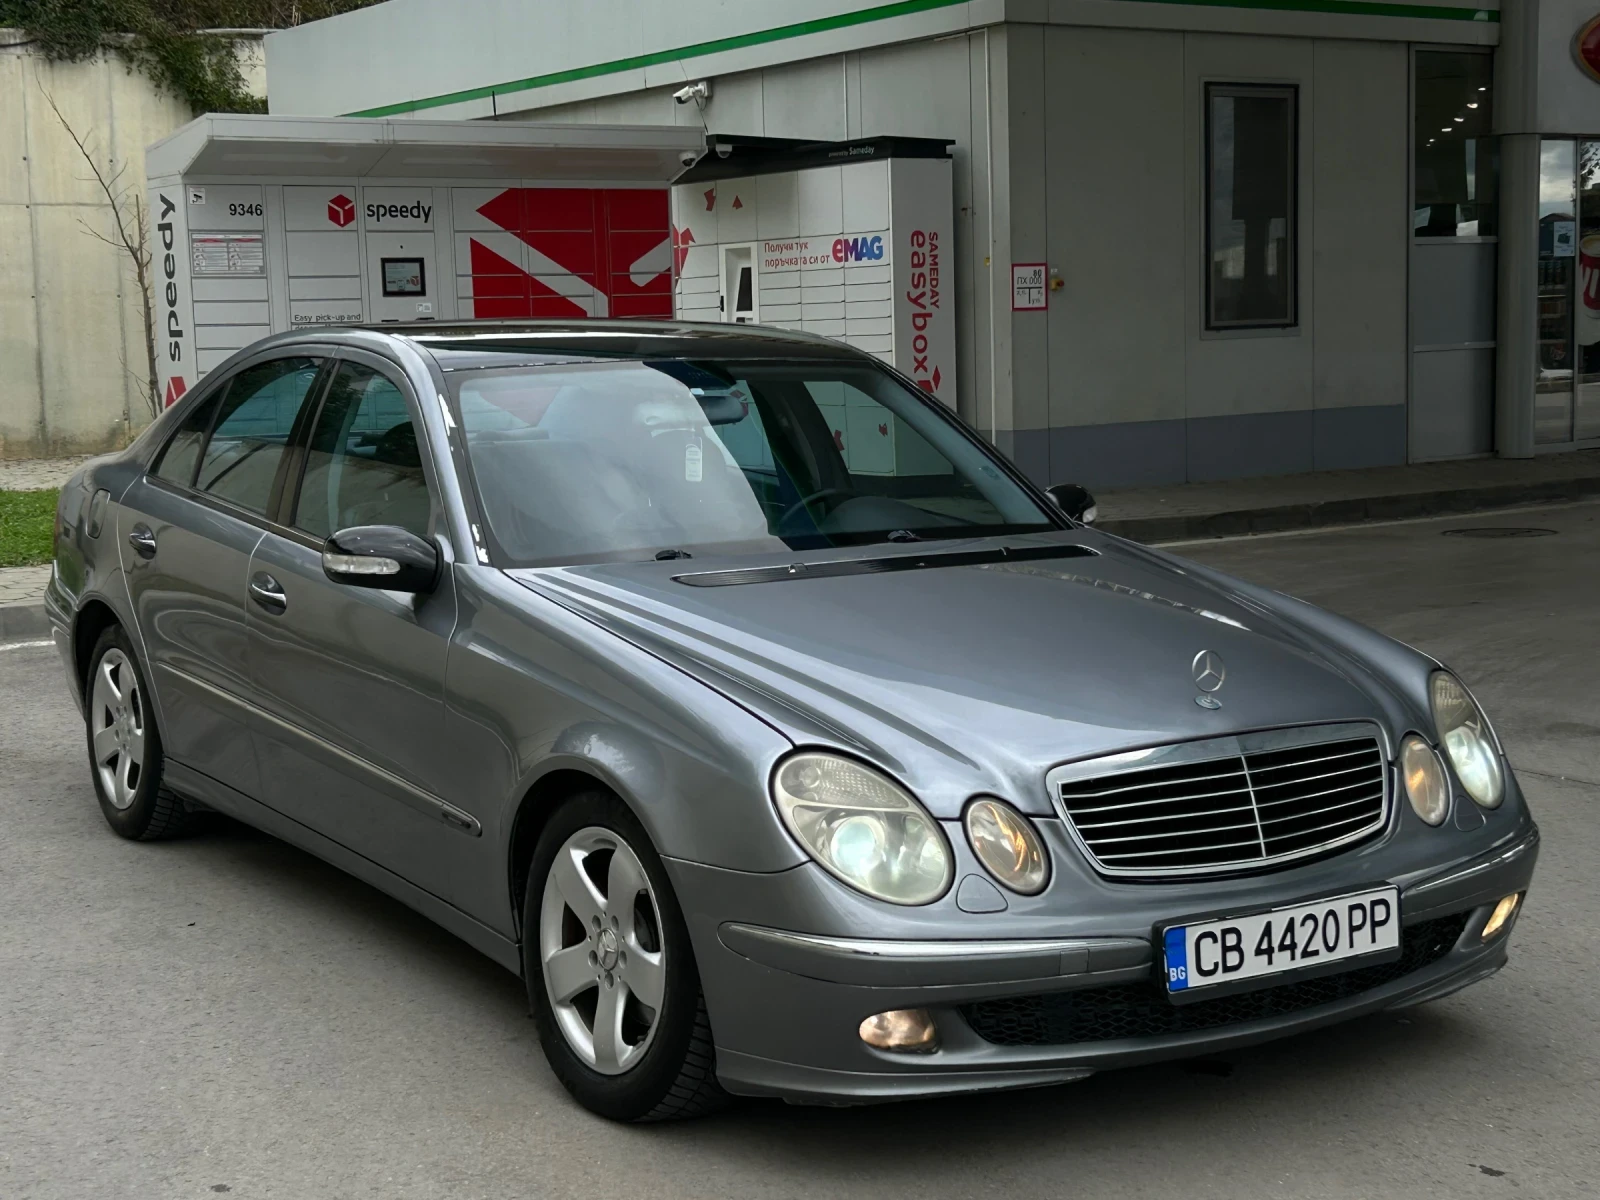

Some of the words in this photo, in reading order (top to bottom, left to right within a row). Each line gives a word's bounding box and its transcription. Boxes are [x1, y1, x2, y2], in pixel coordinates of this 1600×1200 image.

[850, 146, 874, 155] Sameday
[229, 203, 263, 216] 9346
[366, 200, 432, 223] speedy
[764, 242, 794, 254] Получи
[795, 241, 809, 253] тук
[832, 235, 883, 263] eMAG
[765, 255, 807, 269] поръчката
[809, 255, 819, 265] си
[820, 254, 830, 264] от
[158, 193, 184, 362] speedy
[928, 231, 939, 309] SAMEDAY
[1016, 276, 1028, 285] ПХ
[907, 230, 932, 374] easybox
[294, 314, 313, 322] Easy
[315, 313, 345, 322] pick-up
[346, 313, 361, 321] and
[1194, 926, 1245, 977] CB
[1254, 909, 1340, 966] 4420
[1348, 898, 1391, 949] PP
[1169, 966, 1186, 982] BG
